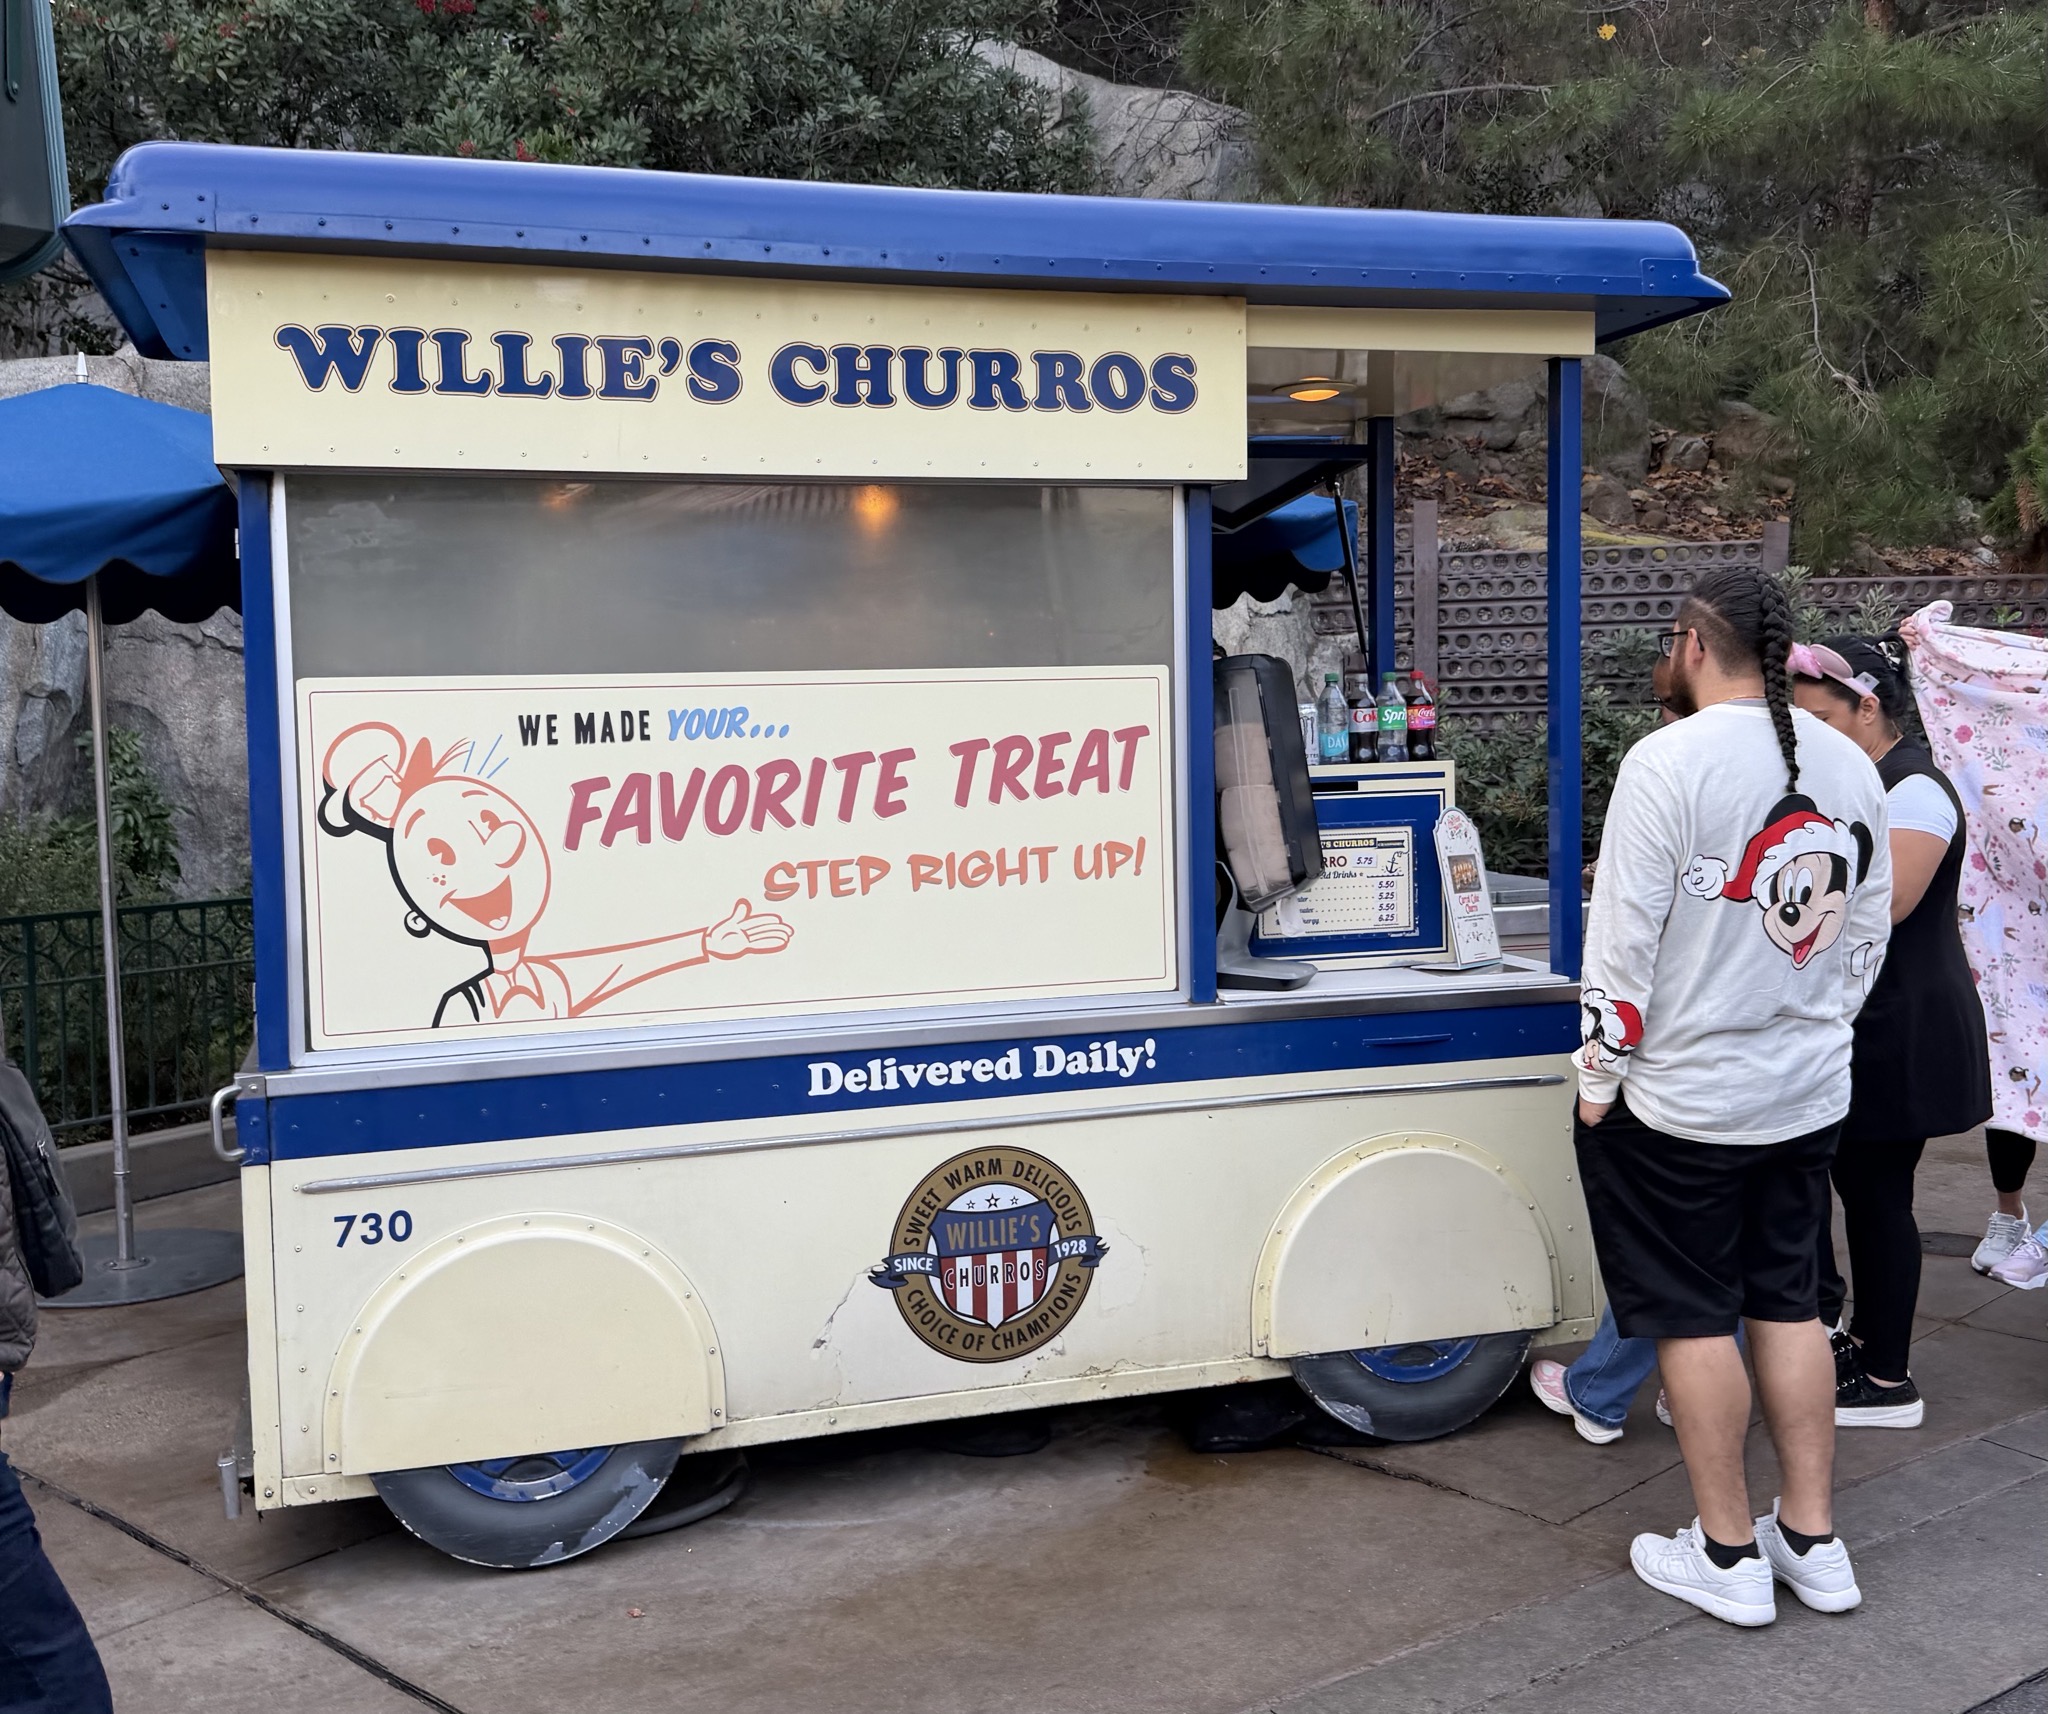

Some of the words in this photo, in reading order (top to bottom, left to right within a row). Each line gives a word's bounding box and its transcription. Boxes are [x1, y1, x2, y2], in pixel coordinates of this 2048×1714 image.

[273, 322, 743, 405] WILLIE'S
[766, 341, 1199, 414] CHURROS
[518, 713, 559, 746] WE
[574, 709, 651, 744] MADE
[667, 706, 790, 741] YOUR...
[563, 747, 917, 852] FAVORITE
[948, 724, 1151, 809] TREAT
[1333, 838, 1375, 848] CHURROS
[763, 854, 891, 901] STEP
[906, 845, 1058, 893] RIGHT
[1073, 836, 1147, 880] UP!
[1333, 870, 1358, 879] Drinks
[1356, 856, 1374, 865] 5.75
[1378, 880, 1395, 889] 5.50
[1378, 892, 1395, 900] 5.25
[1378, 903, 1395, 912] 5.50
[1378, 913, 1395, 922] 6.25
[807, 1048, 1023, 1097] Delivered
[1032, 1038, 1156, 1078] Daily!
[904, 1188, 942, 1247] SWEET
[944, 1158, 1002, 1191] WARM
[1012, 1160, 1082, 1232] DELICIOUS
[333, 1209, 413, 1248] 730
[946, 1214, 1041, 1250] WILLIE'S
[893, 1257, 933, 1272] SINCE
[1054, 1239, 1087, 1258] 1928
[944, 1259, 1045, 1289] CHURROS
[907, 1289, 959, 1345] CHOICE
[962, 1333, 985, 1352] OF
[991, 1273, 1081, 1351] CHAMPIONS
